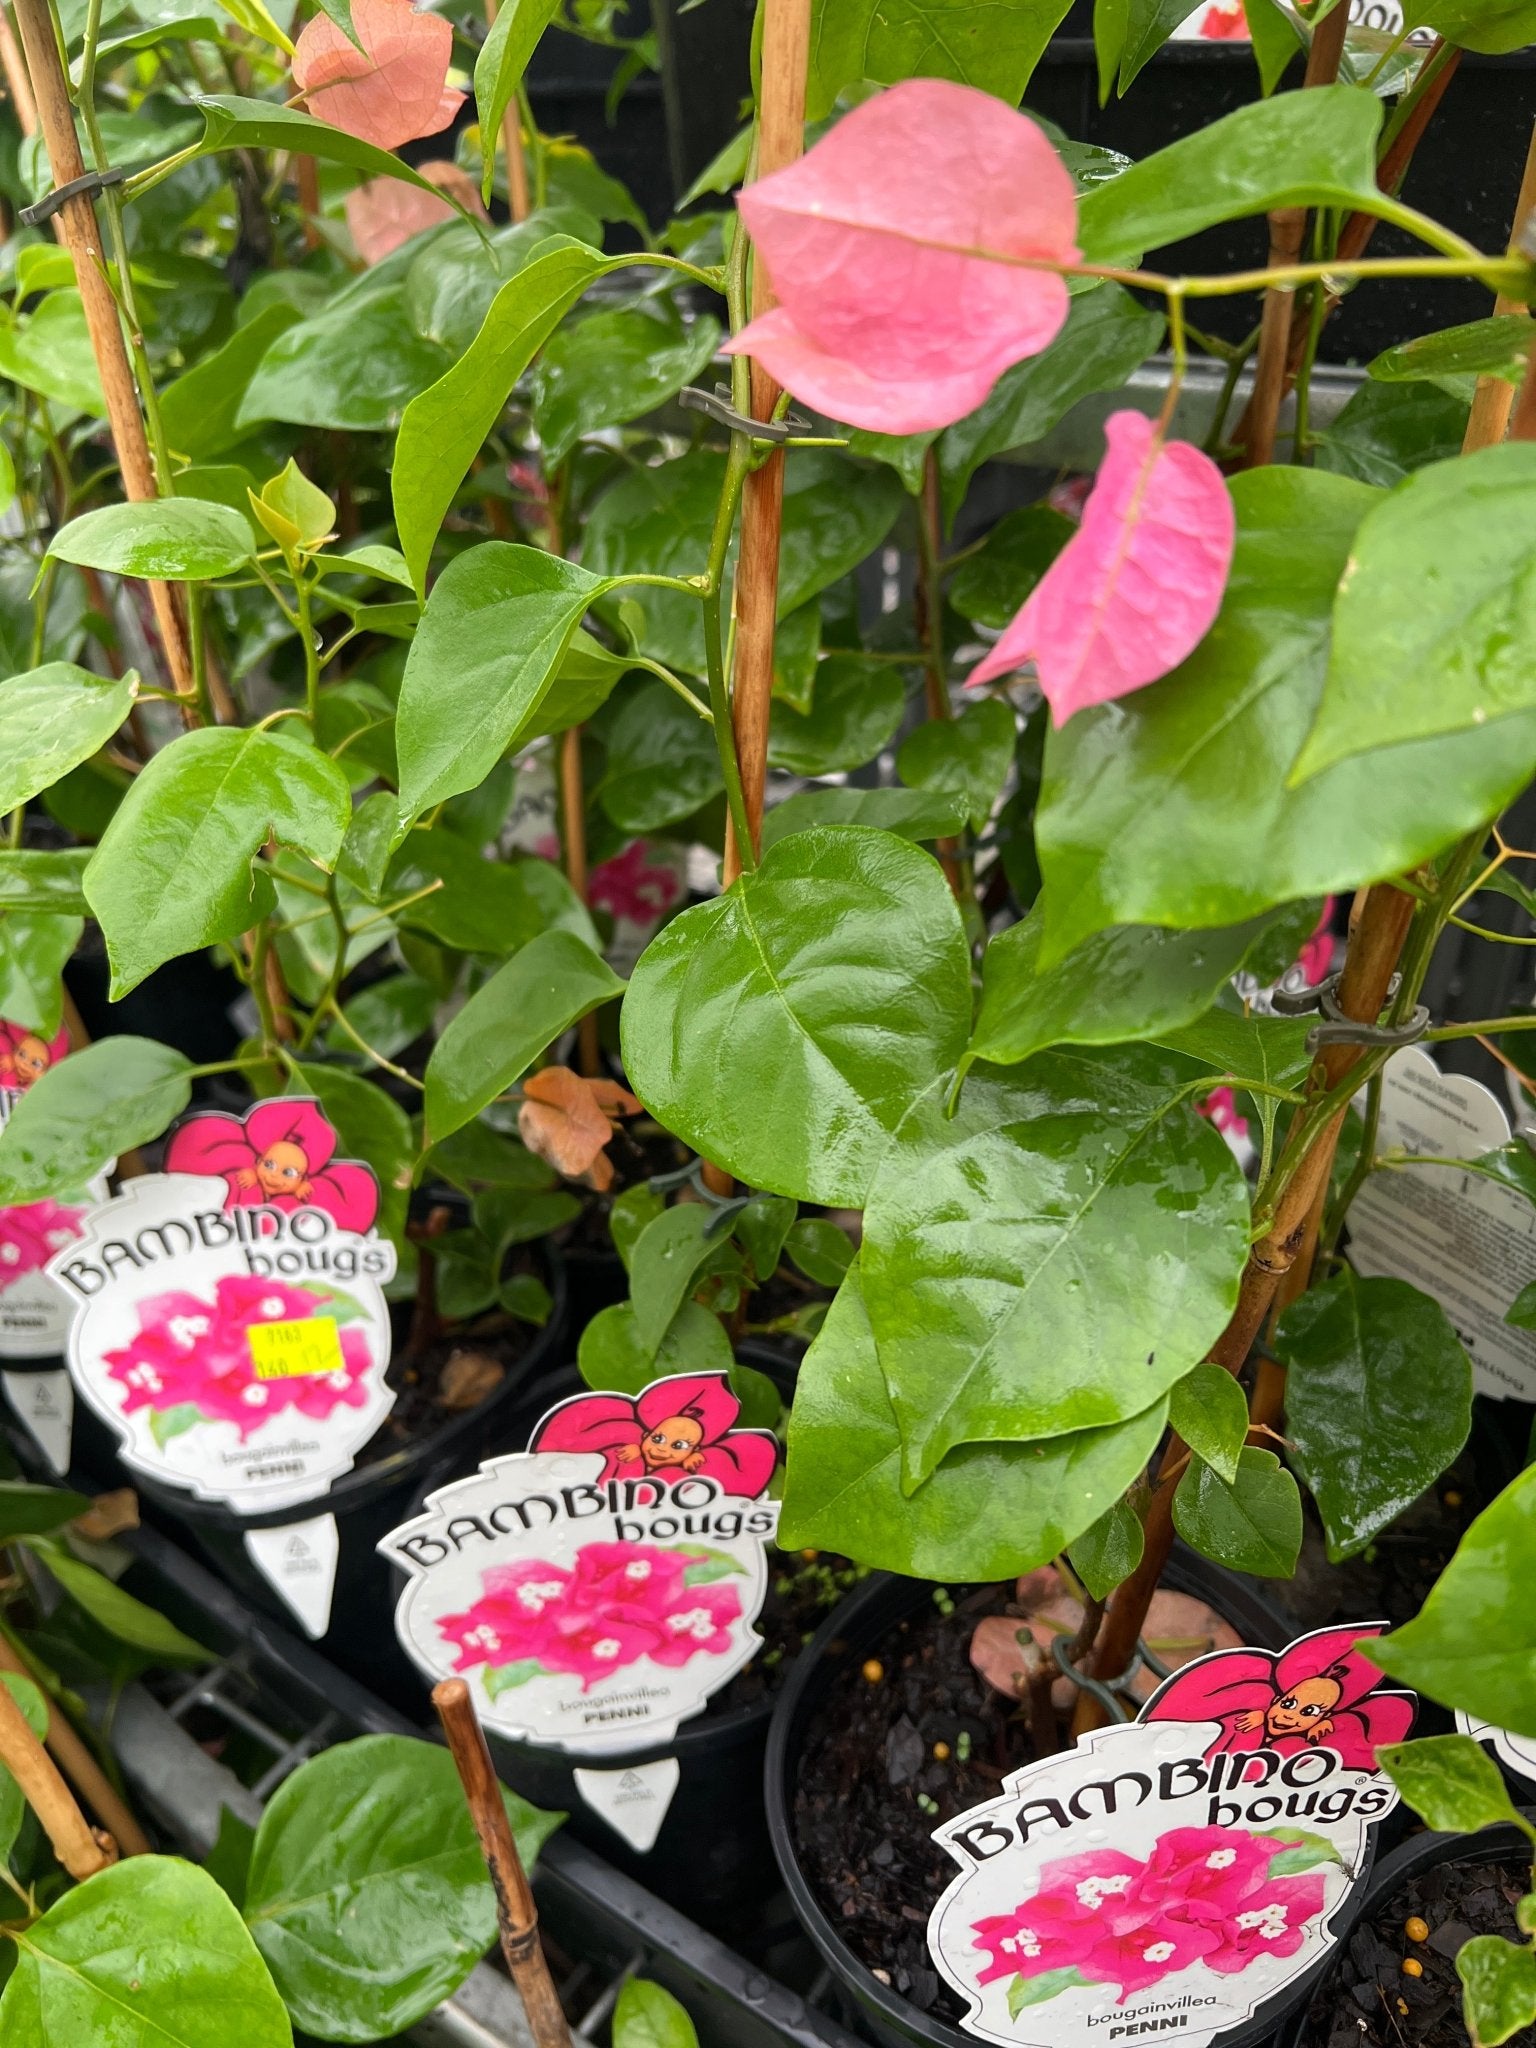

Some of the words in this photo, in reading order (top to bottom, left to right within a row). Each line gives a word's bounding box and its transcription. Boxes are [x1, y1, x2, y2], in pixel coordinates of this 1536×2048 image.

[60, 1206, 328, 1295] BAMBINO
[244, 1248, 385, 1280] bougs
[399, 1477, 717, 1567] BAMBINO
[615, 1508, 774, 1541] bougs
[584, 1704, 651, 1724] PENNI
[951, 1749, 1337, 1861] BAMBINO
[1207, 1783, 1389, 1828] bougs
[1086, 1993, 1217, 2029] bougainvillea
[1108, 2015, 1189, 2041] PENNI
